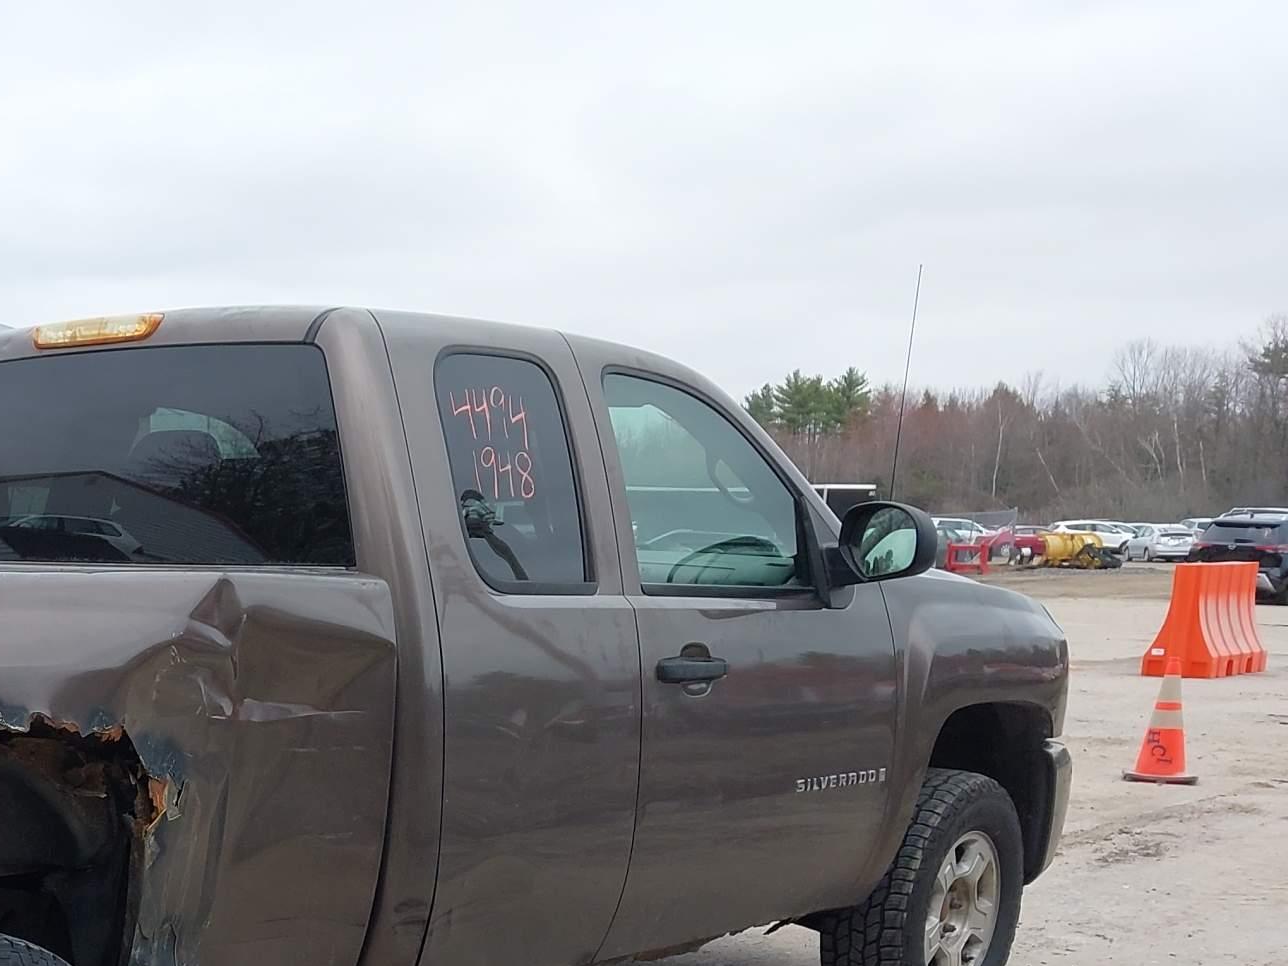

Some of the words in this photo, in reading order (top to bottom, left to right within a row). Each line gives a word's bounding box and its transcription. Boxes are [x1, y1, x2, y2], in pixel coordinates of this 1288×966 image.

[450, 386, 529, 450] 4494
[472, 446, 535, 499] 1948
[796, 769, 877, 793] SILVERADO
